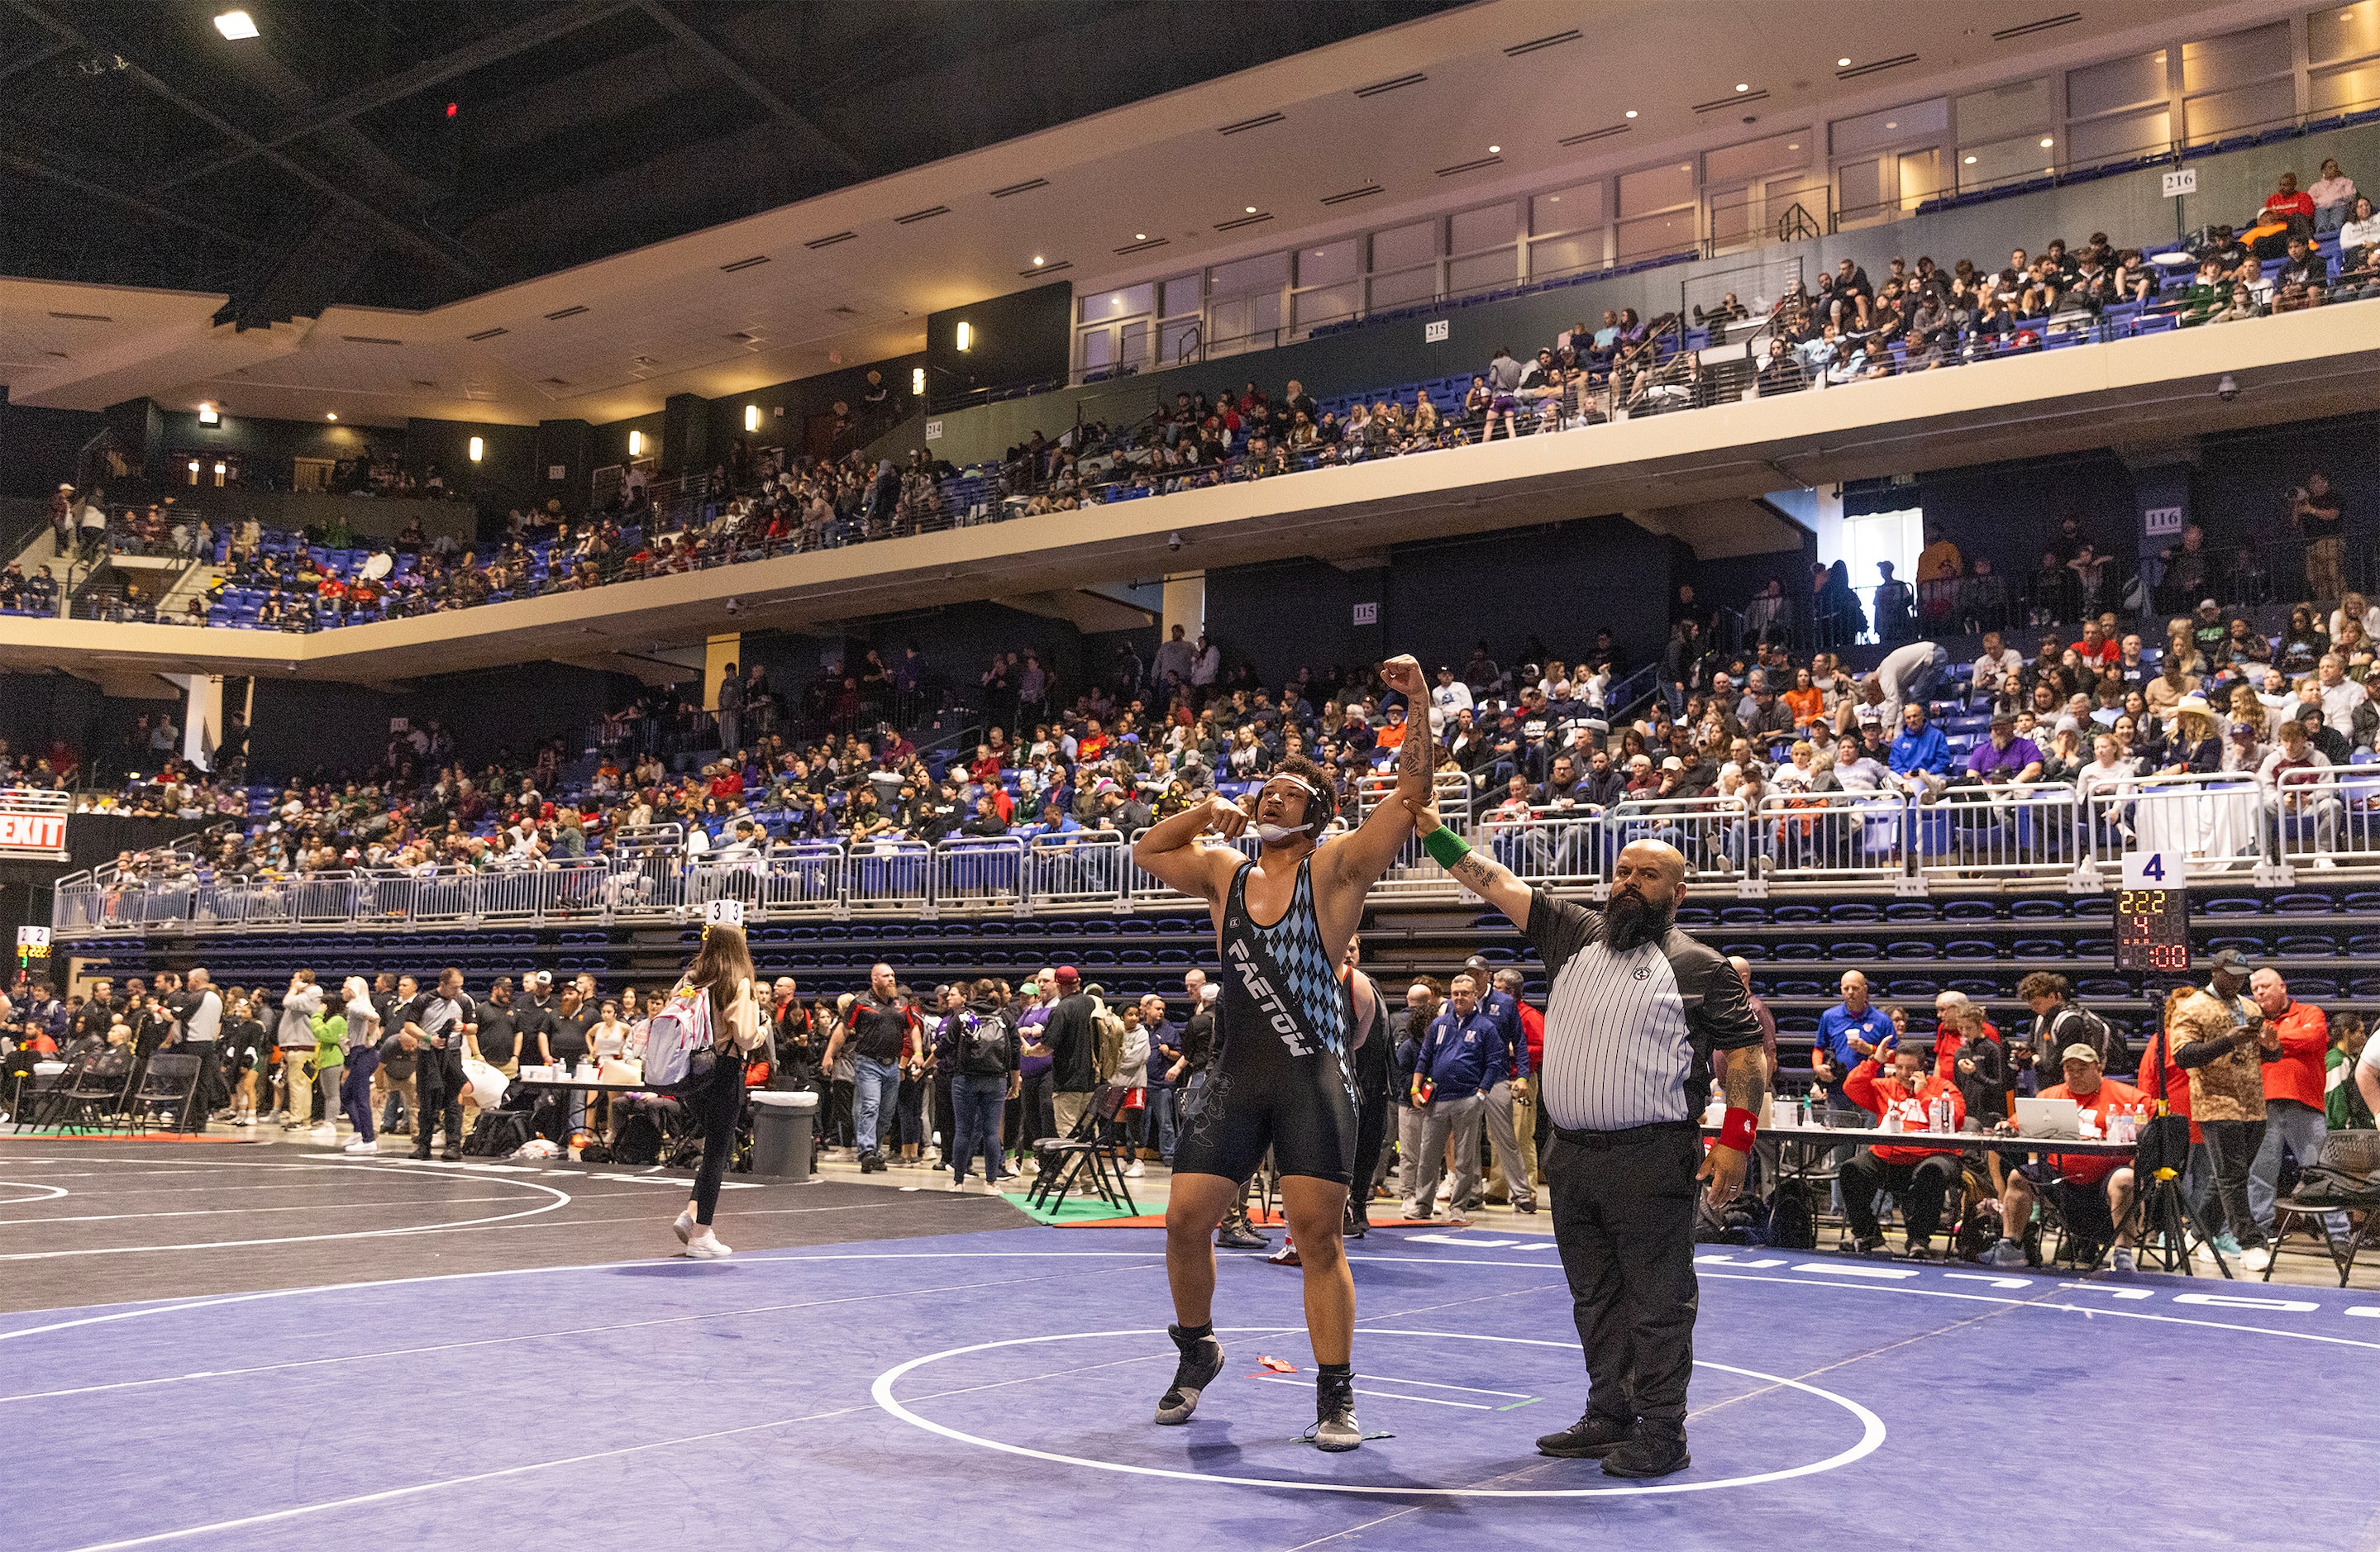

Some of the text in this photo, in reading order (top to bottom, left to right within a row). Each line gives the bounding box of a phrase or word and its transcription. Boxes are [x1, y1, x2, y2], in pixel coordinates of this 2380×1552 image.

[2166, 174, 2193, 188] 216
[1428, 322, 1447, 336] 215
[2151, 512, 2178, 527] 116
[1357, 605, 1375, 618] 115
[0, 815, 64, 846] EXIT
[2142, 853, 2166, 882] 4
[2119, 889, 2167, 914] 222
[713, 902, 722, 921] 3
[732, 902, 740, 921] 3
[21, 928, 27, 941] 2
[2133, 916, 2149, 935] 4
[36, 929, 45, 942] 2
[1228, 938, 1315, 1058] PAETOW
